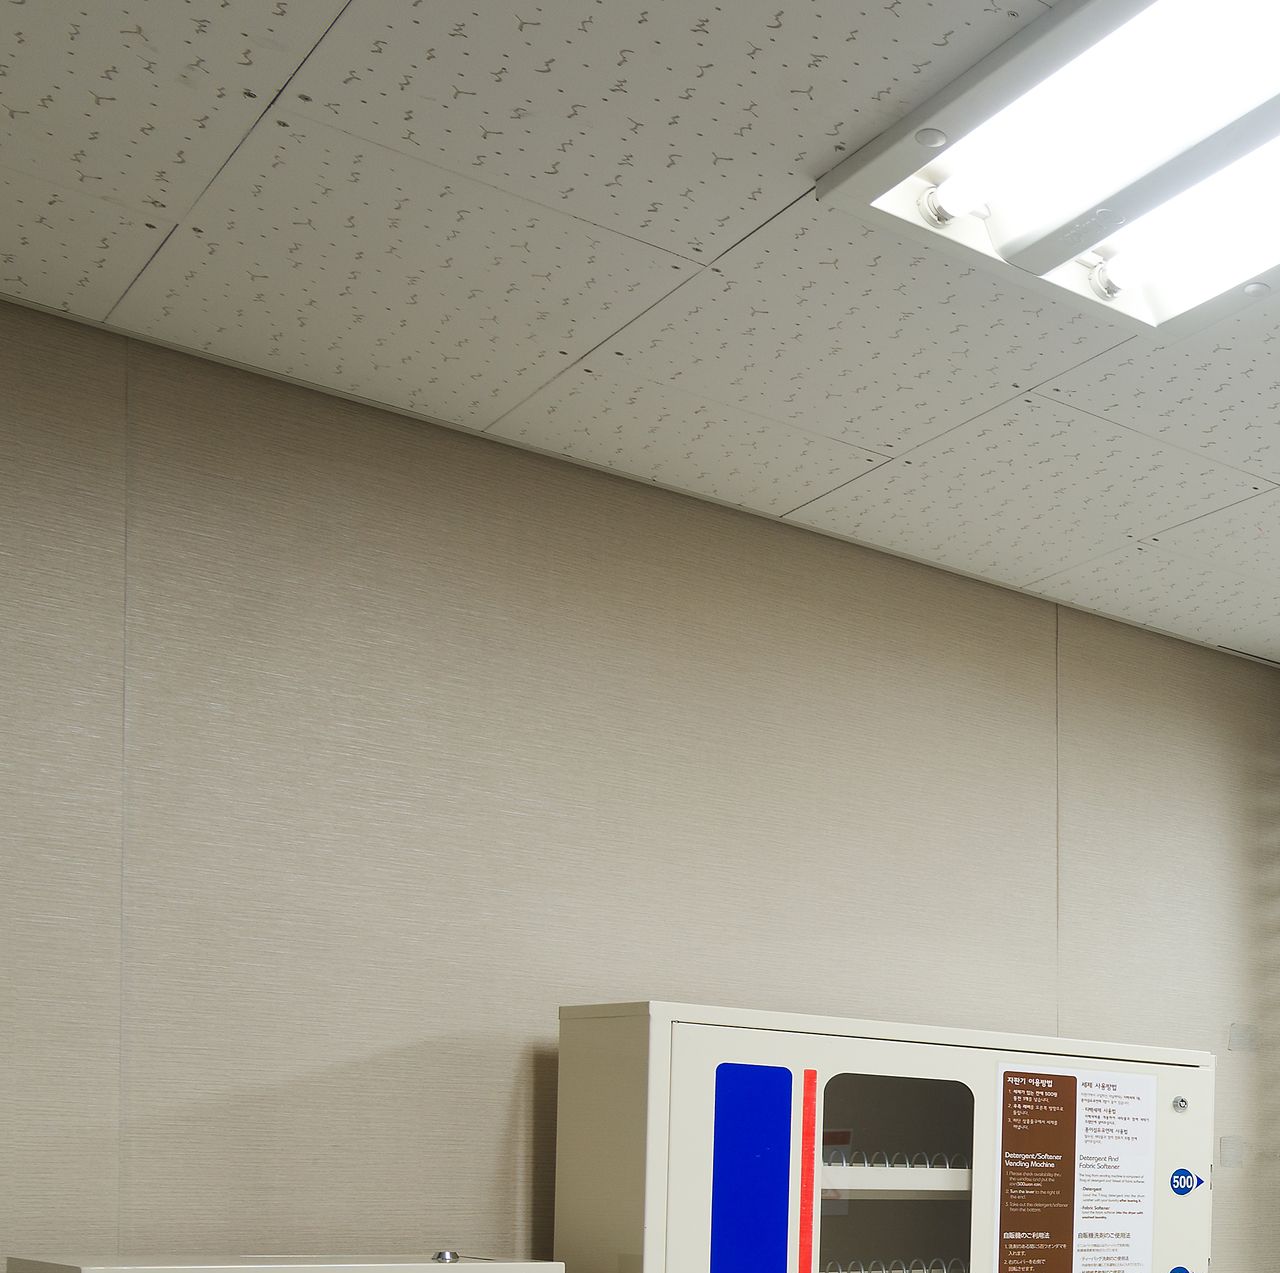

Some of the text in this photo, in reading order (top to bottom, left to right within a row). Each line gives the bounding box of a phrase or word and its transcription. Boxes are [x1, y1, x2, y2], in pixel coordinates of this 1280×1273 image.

[1007, 1077, 1026, 1086] 자판기
[1005, 1152, 1062, 1160] Detergent/Softener
[1005, 1160, 1029, 1168] Vending
[1172, 1175, 1192, 1189] 500
